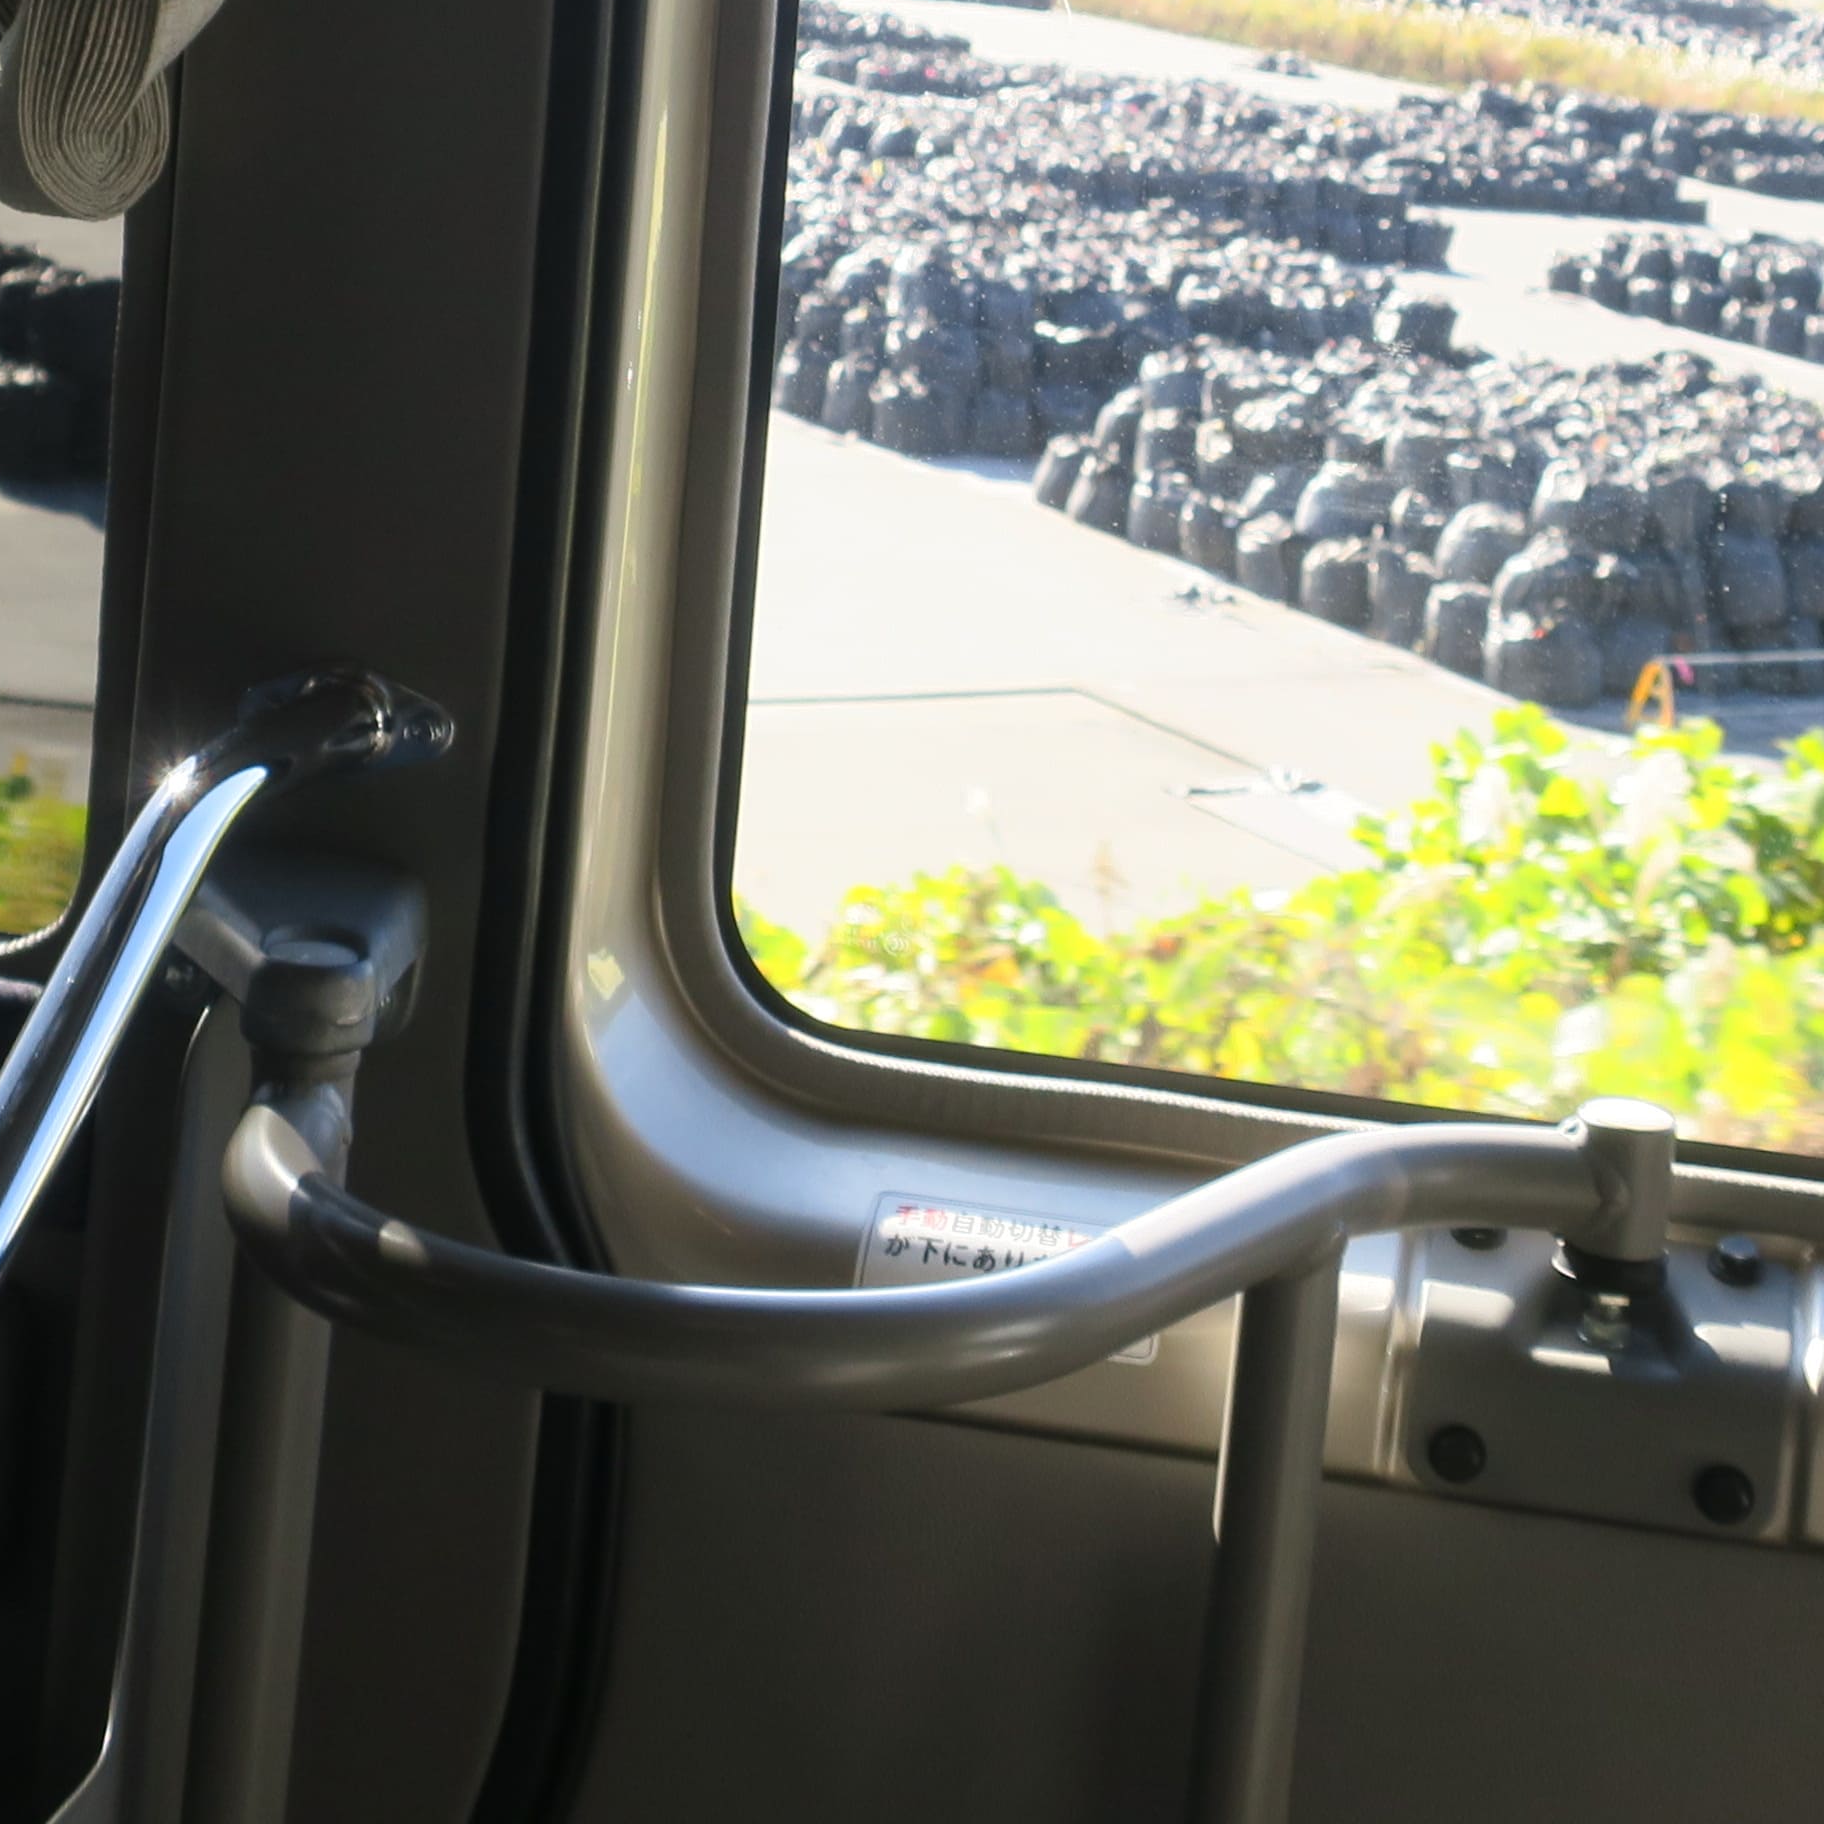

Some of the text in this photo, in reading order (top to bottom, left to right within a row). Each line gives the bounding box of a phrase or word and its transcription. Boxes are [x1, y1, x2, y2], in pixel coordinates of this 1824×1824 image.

[884, 1234, 1049, 1273] が下にあり
